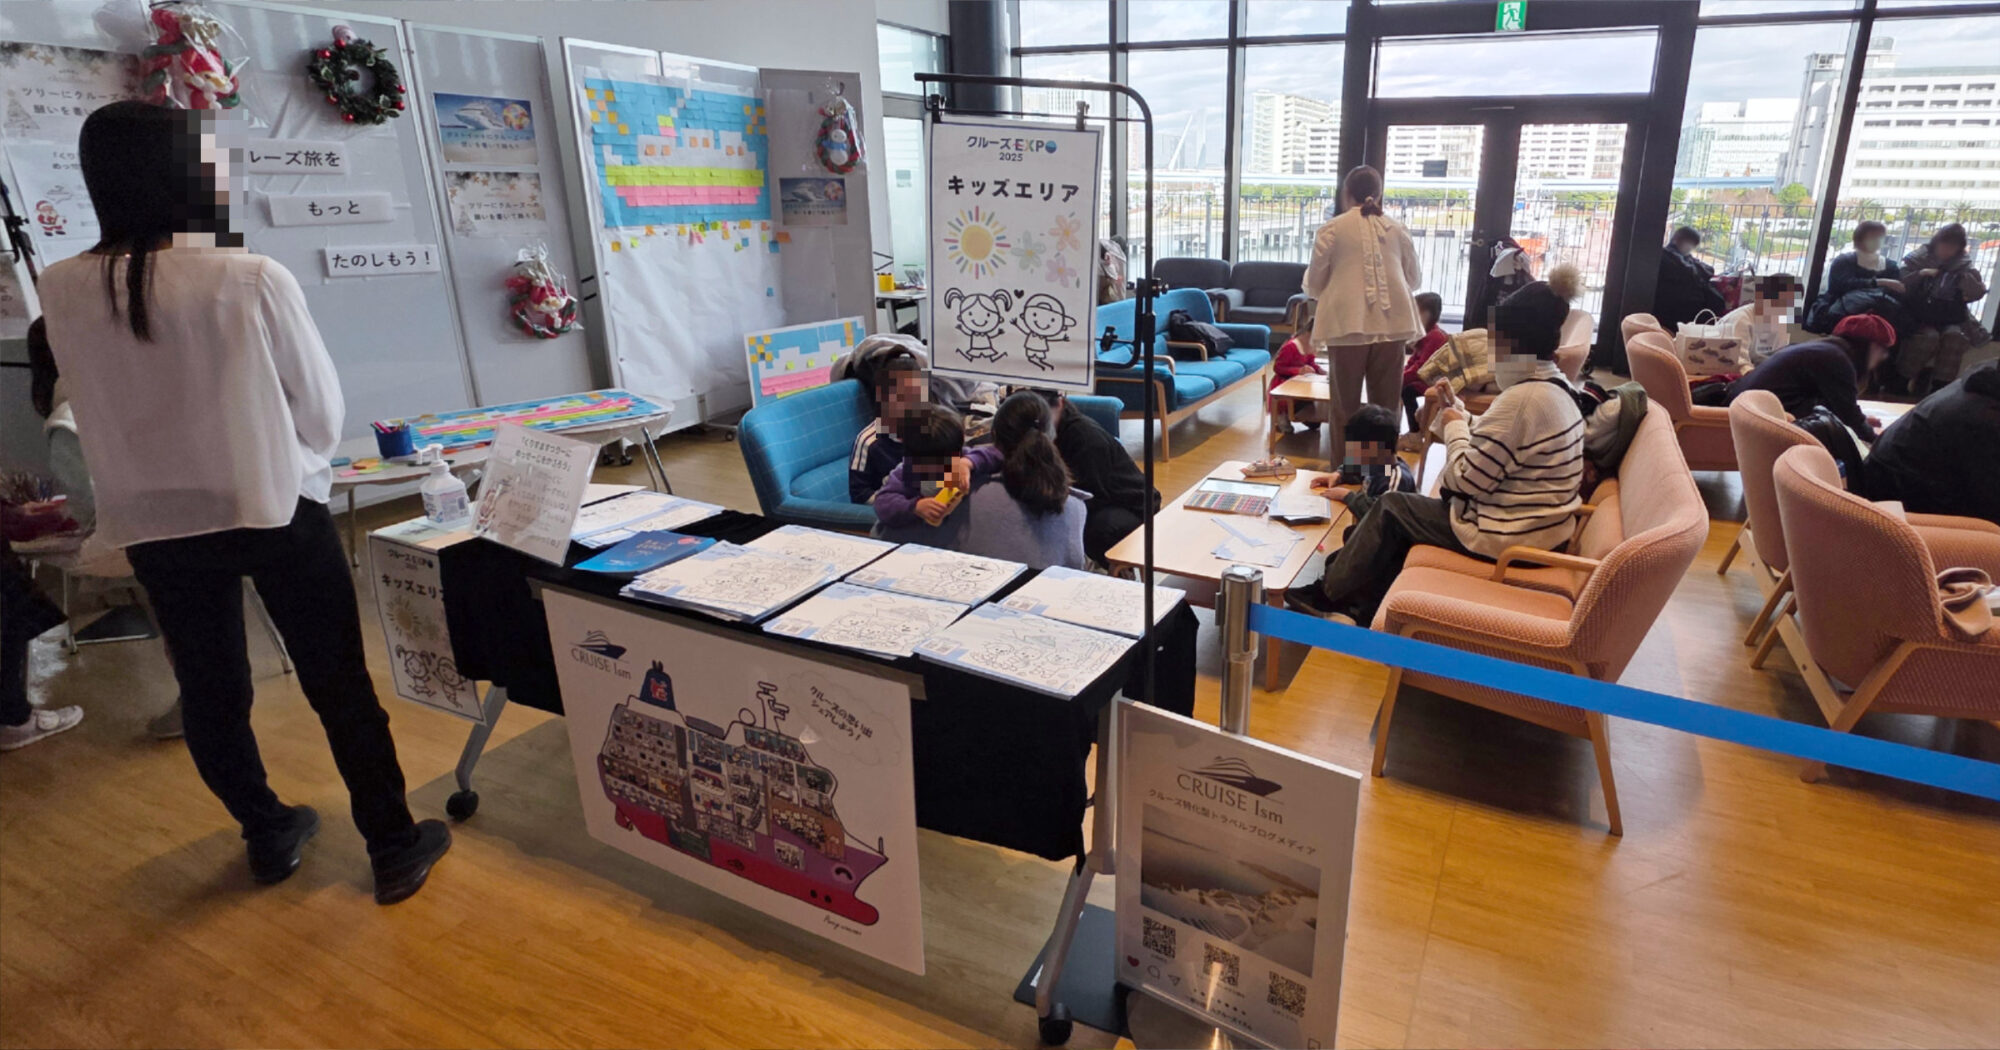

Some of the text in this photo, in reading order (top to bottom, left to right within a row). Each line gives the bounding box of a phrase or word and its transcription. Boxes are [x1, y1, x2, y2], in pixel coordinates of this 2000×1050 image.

[998, 151, 1024, 162] 2025
[947, 175, 1080, 203] キッズエリア
[307, 199, 362, 217] もっと
[331, 250, 433, 268] たのしもう！
[381, 573, 444, 599] キッズエリ
[570, 647, 611, 673] CRUISE
[1176, 773, 1283, 824] CRUISE Ism
[1148, 788, 1317, 856] クルーズ特化型トラベルブログメディア
